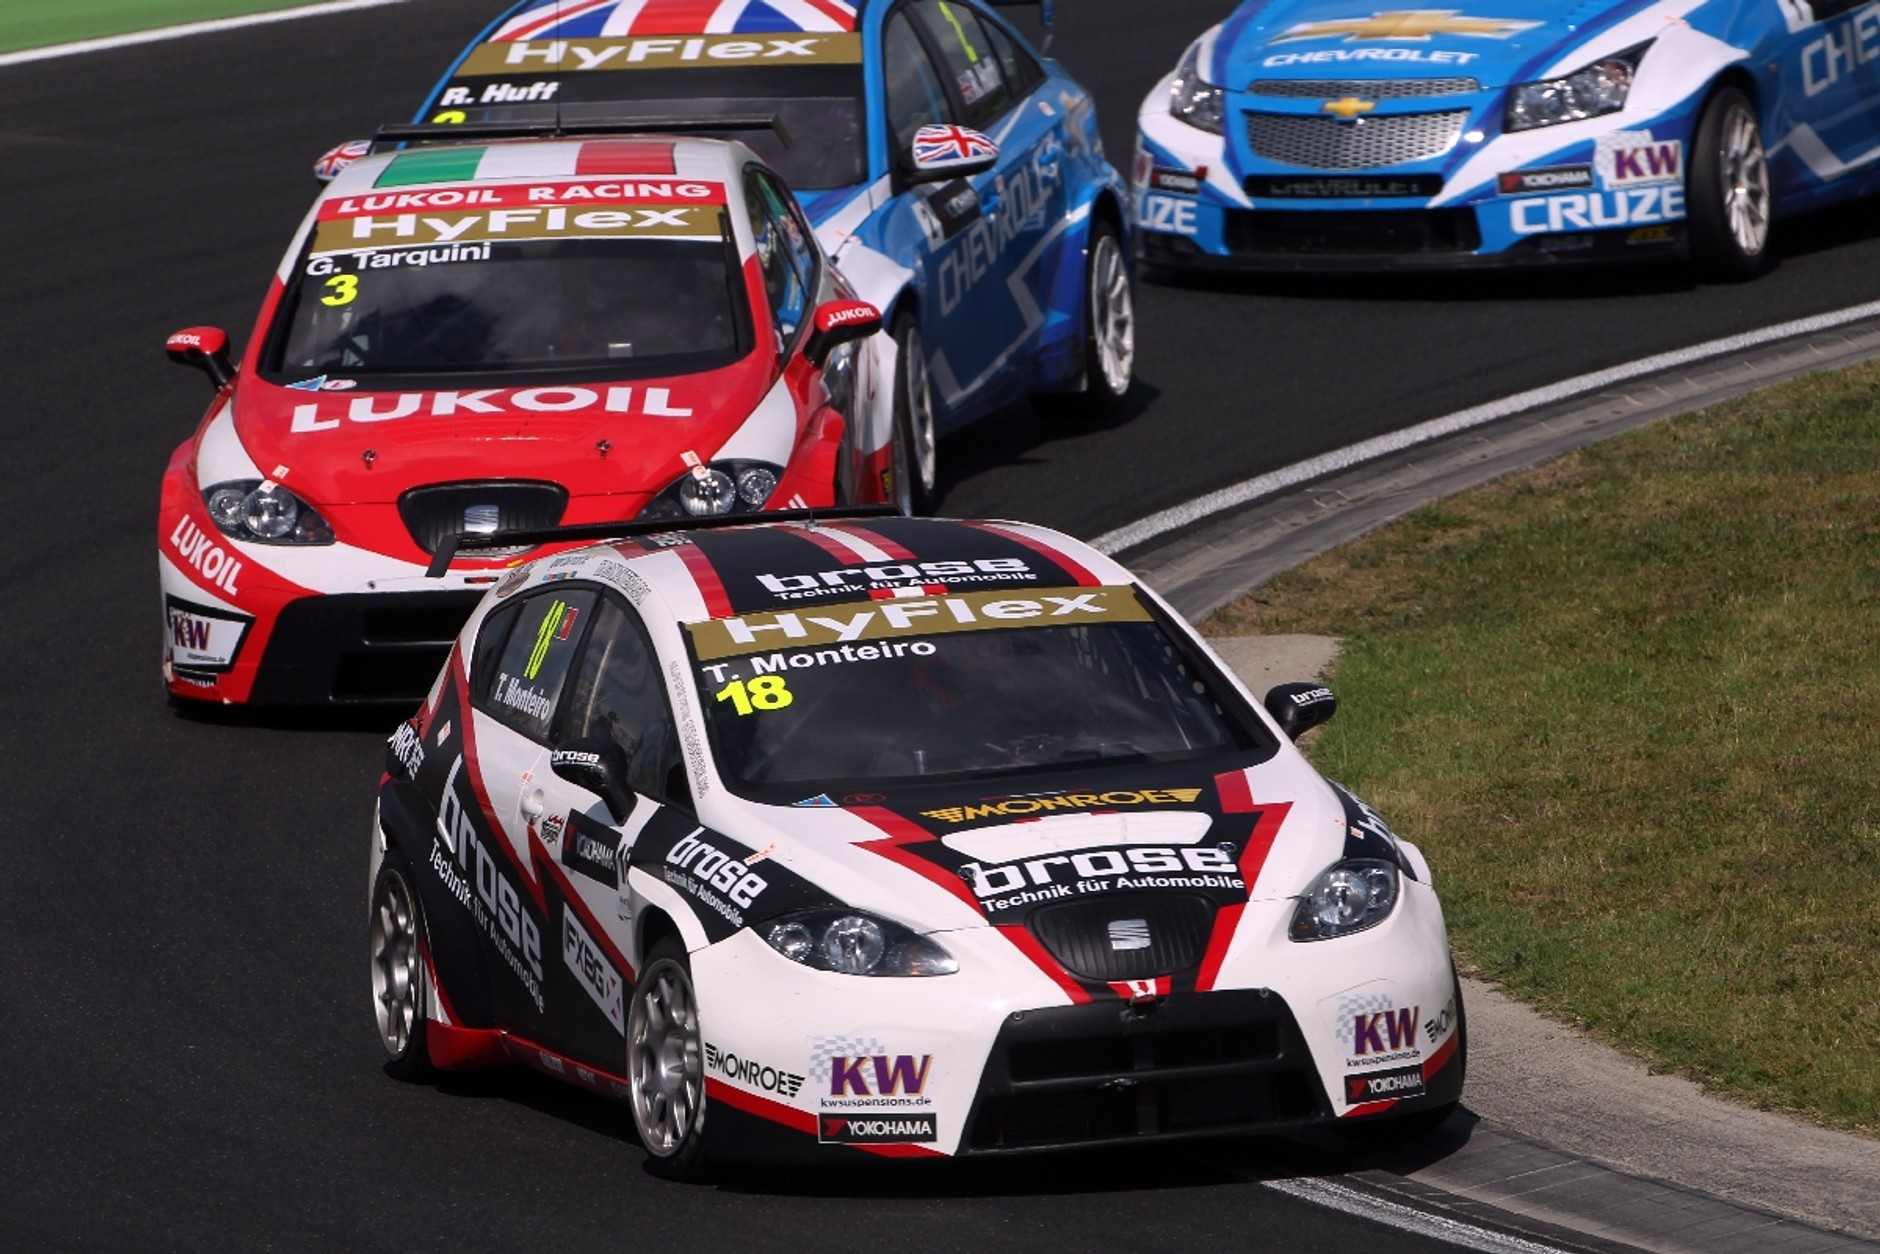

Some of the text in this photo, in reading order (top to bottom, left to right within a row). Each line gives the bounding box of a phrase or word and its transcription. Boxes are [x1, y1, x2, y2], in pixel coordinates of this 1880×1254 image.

[504, 34, 818, 70] HyFlex
[1262, 48, 1480, 67] CHEVROLET
[440, 82, 558, 107] R. Huff
[1615, 144, 1680, 179] KW
[338, 183, 711, 214] LUKOIL RACING
[1510, 187, 1687, 234] CRUZE
[352, 207, 692, 242] HyFlex
[306, 242, 491, 277] G. Tarquini
[320, 274, 359, 307] 3
[826, 307, 876, 328] LUKOIL
[290, 387, 692, 433] LUKOIL
[170, 514, 243, 597] LUKOIL
[755, 557, 1031, 593] brose
[774, 582, 867, 600] Technik
[908, 572, 1037, 587] Automobile
[172, 614, 212, 652] KW
[721, 592, 1107, 645] HyFlex
[702, 640, 937, 684] T. Monteiro
[503, 677, 551, 721] Monteiro
[715, 674, 794, 717] 18
[965, 790, 1167, 821] MONROE
[430, 837, 472, 906] Technik
[665, 826, 768, 909] brose
[973, 846, 1237, 899] brose
[699, 884, 744, 928] Automobile
[981, 874, 1244, 914] Technik für Automobile
[1354, 1005, 1420, 1056] KW
[712, 1050, 790, 1096] MONROE
[829, 1054, 934, 1099] KW
[1367, 1072, 1422, 1094] YOKOHAMA
[820, 1096, 933, 1108] kwsuspensions.de
[847, 1119, 933, 1136] YOKOHAMA
